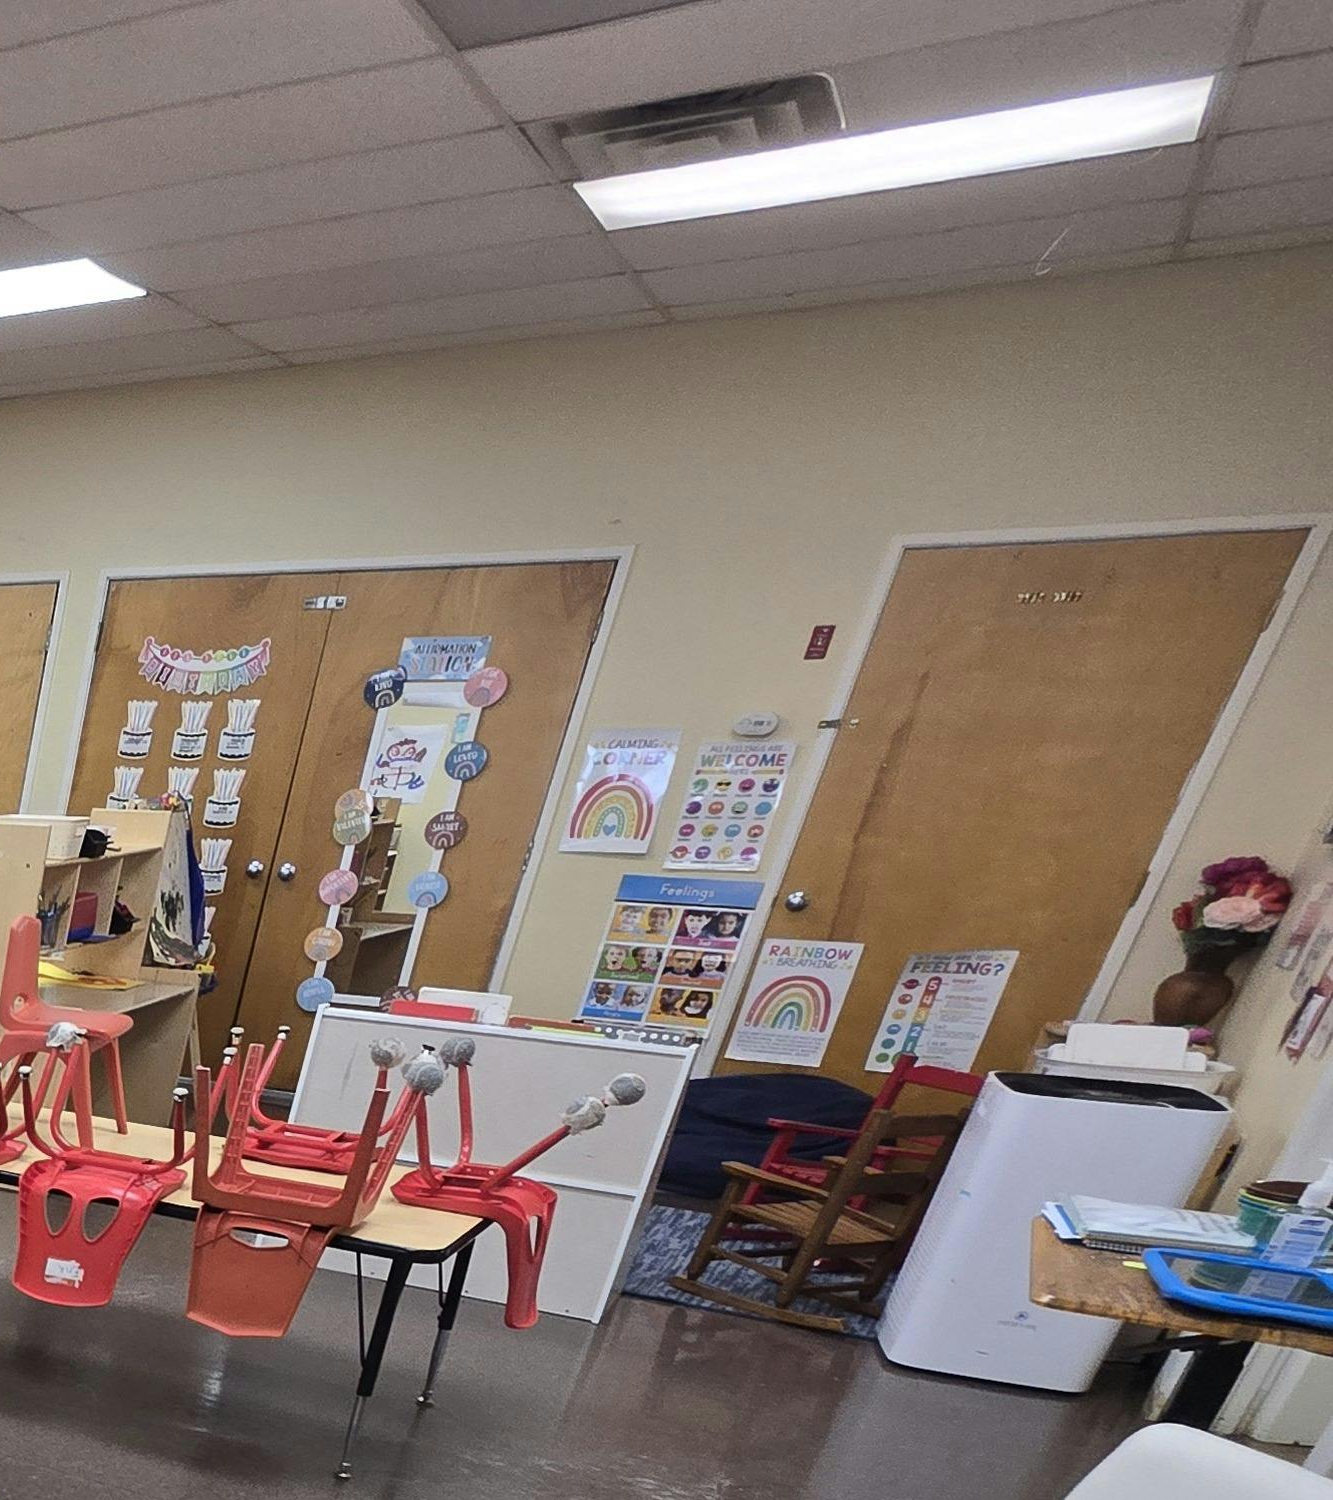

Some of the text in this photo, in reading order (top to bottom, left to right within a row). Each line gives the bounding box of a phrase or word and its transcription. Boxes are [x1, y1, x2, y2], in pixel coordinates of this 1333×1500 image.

[607, 738, 660, 750] CALMING
[700, 753, 788, 768] WELCOME
[658, 882, 717, 902] Feelings
[768, 944, 854, 960] RAINBOW
[775, 957, 838, 969] BREATHING
[909, 960, 1006, 977] FEELING?
